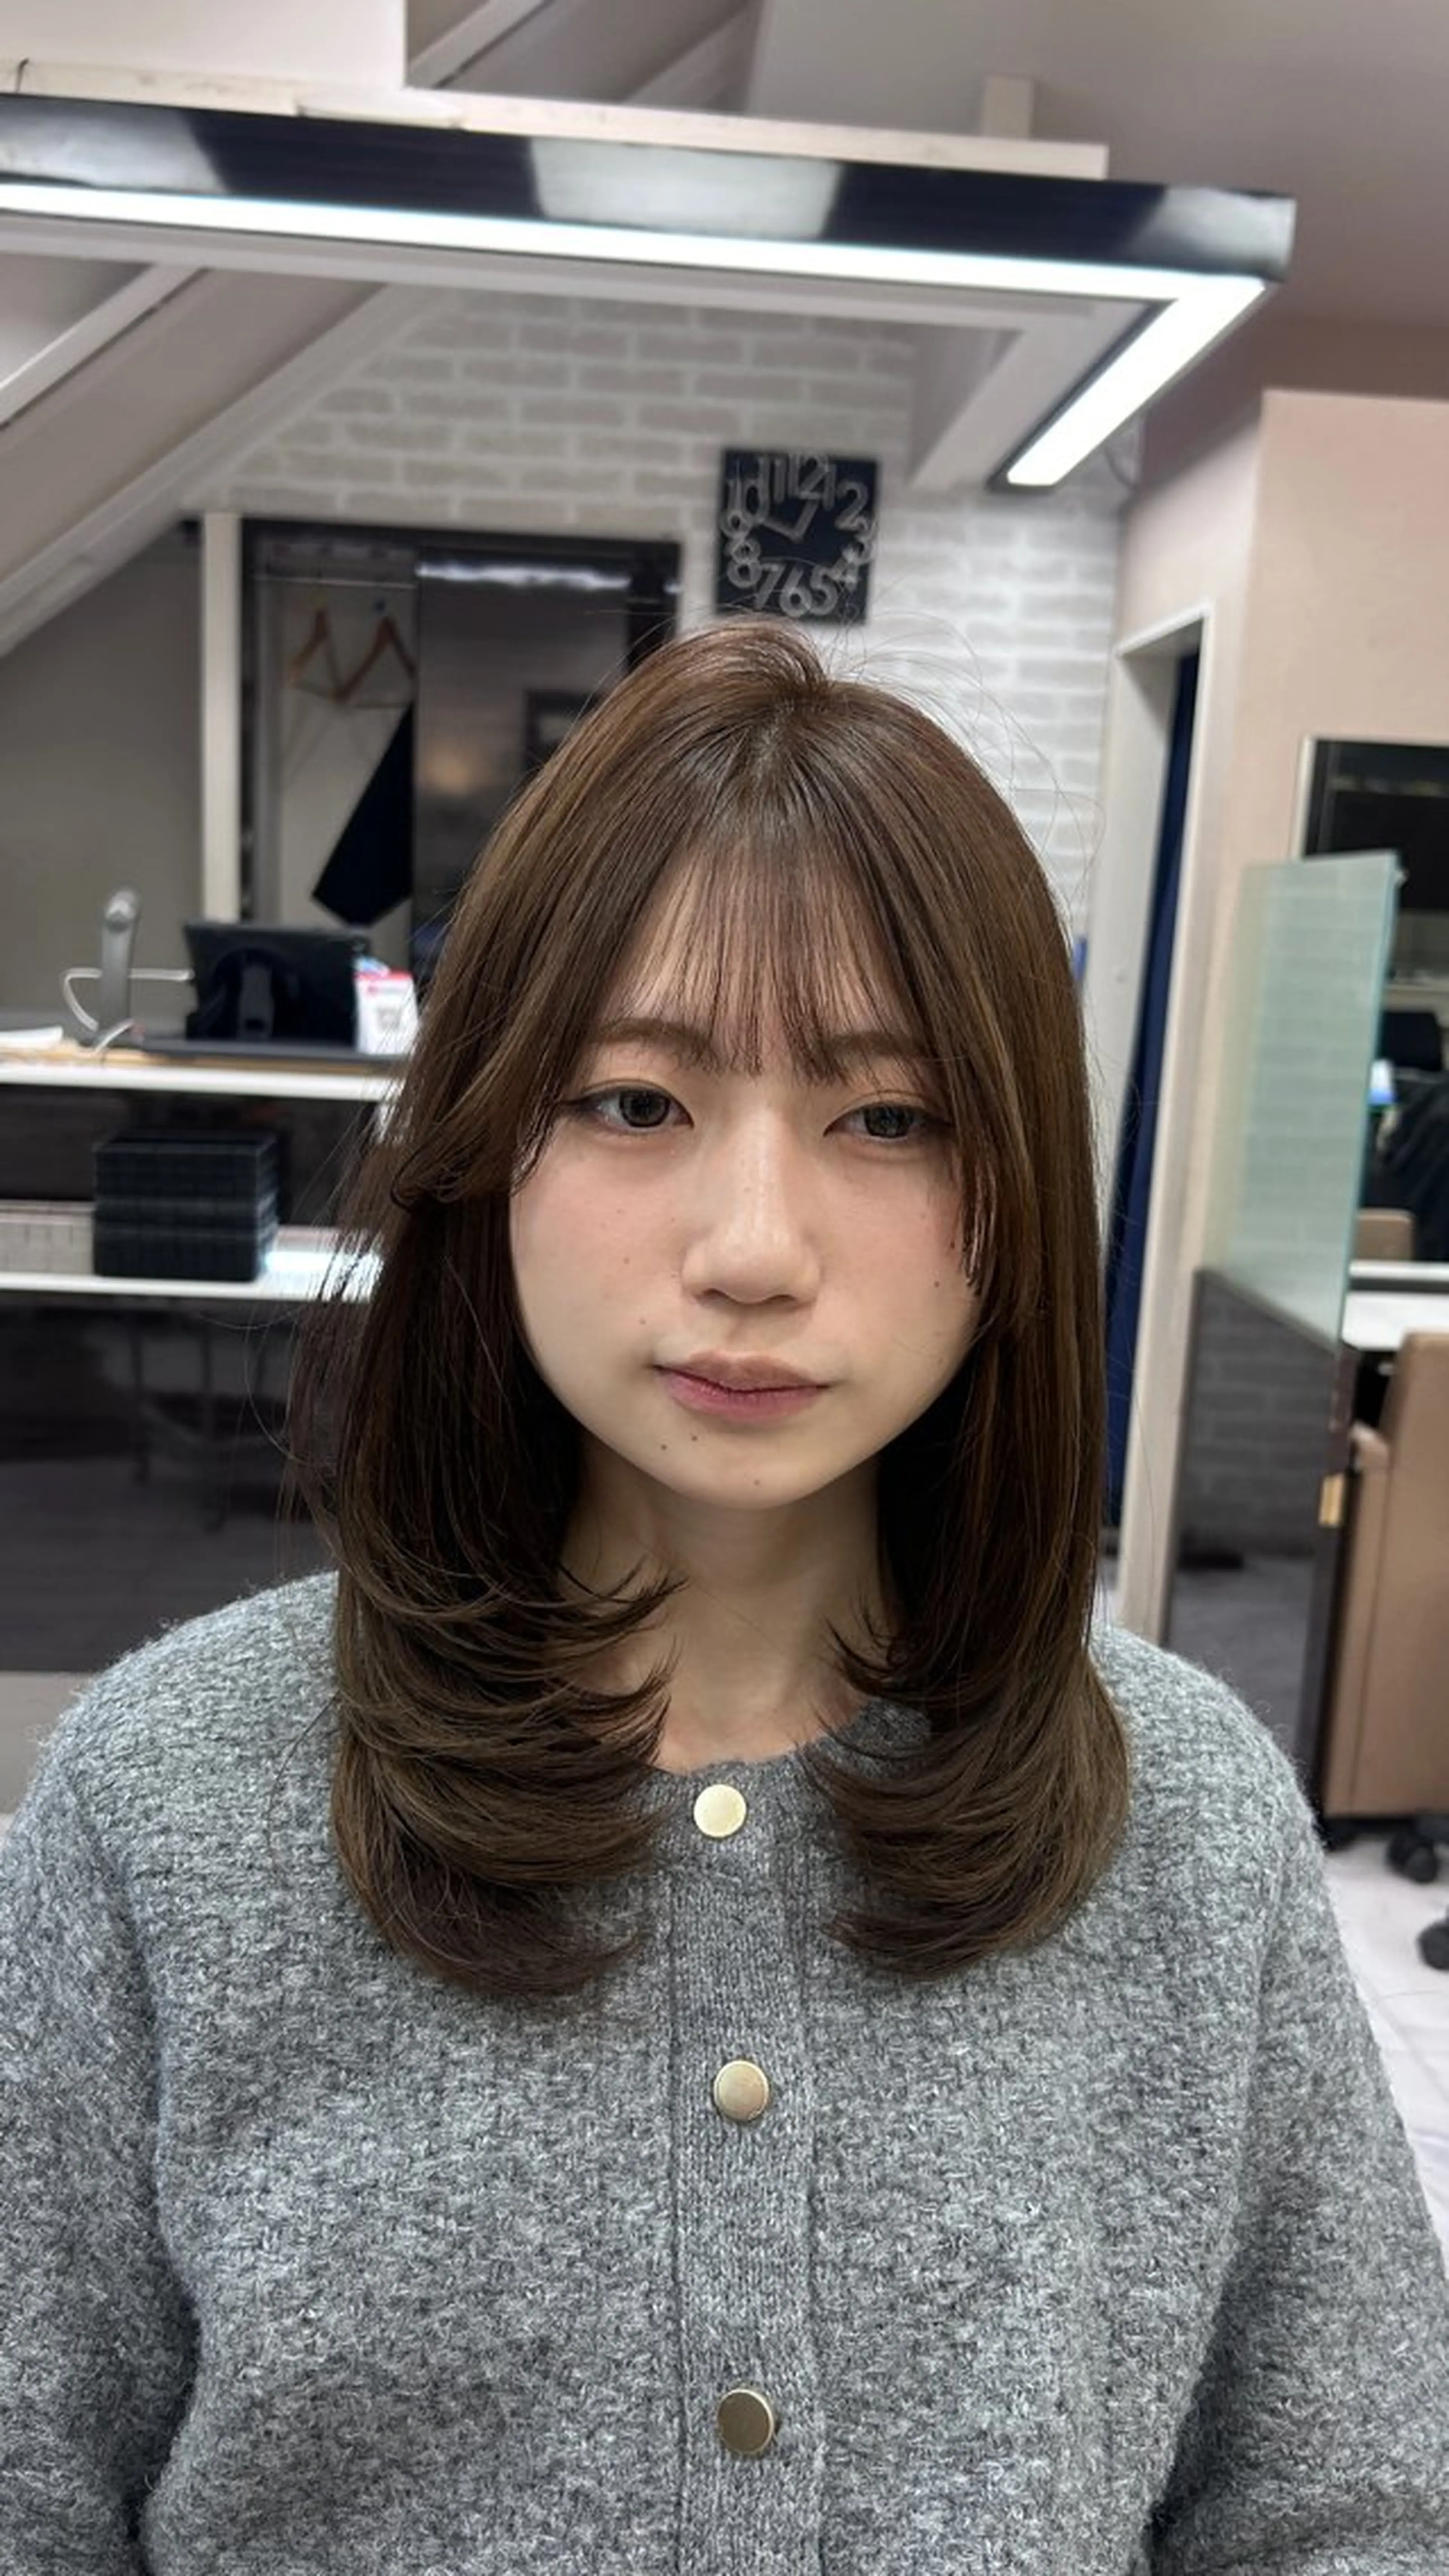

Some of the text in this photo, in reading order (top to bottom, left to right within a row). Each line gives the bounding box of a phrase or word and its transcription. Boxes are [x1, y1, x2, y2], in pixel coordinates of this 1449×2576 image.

[789, 453, 828, 500] 12
[834, 478, 869, 530] 2
[725, 537, 763, 589] 8
[755, 563, 786, 610] 7
[780, 567, 812, 618] 6
[810, 564, 840, 616] 5
